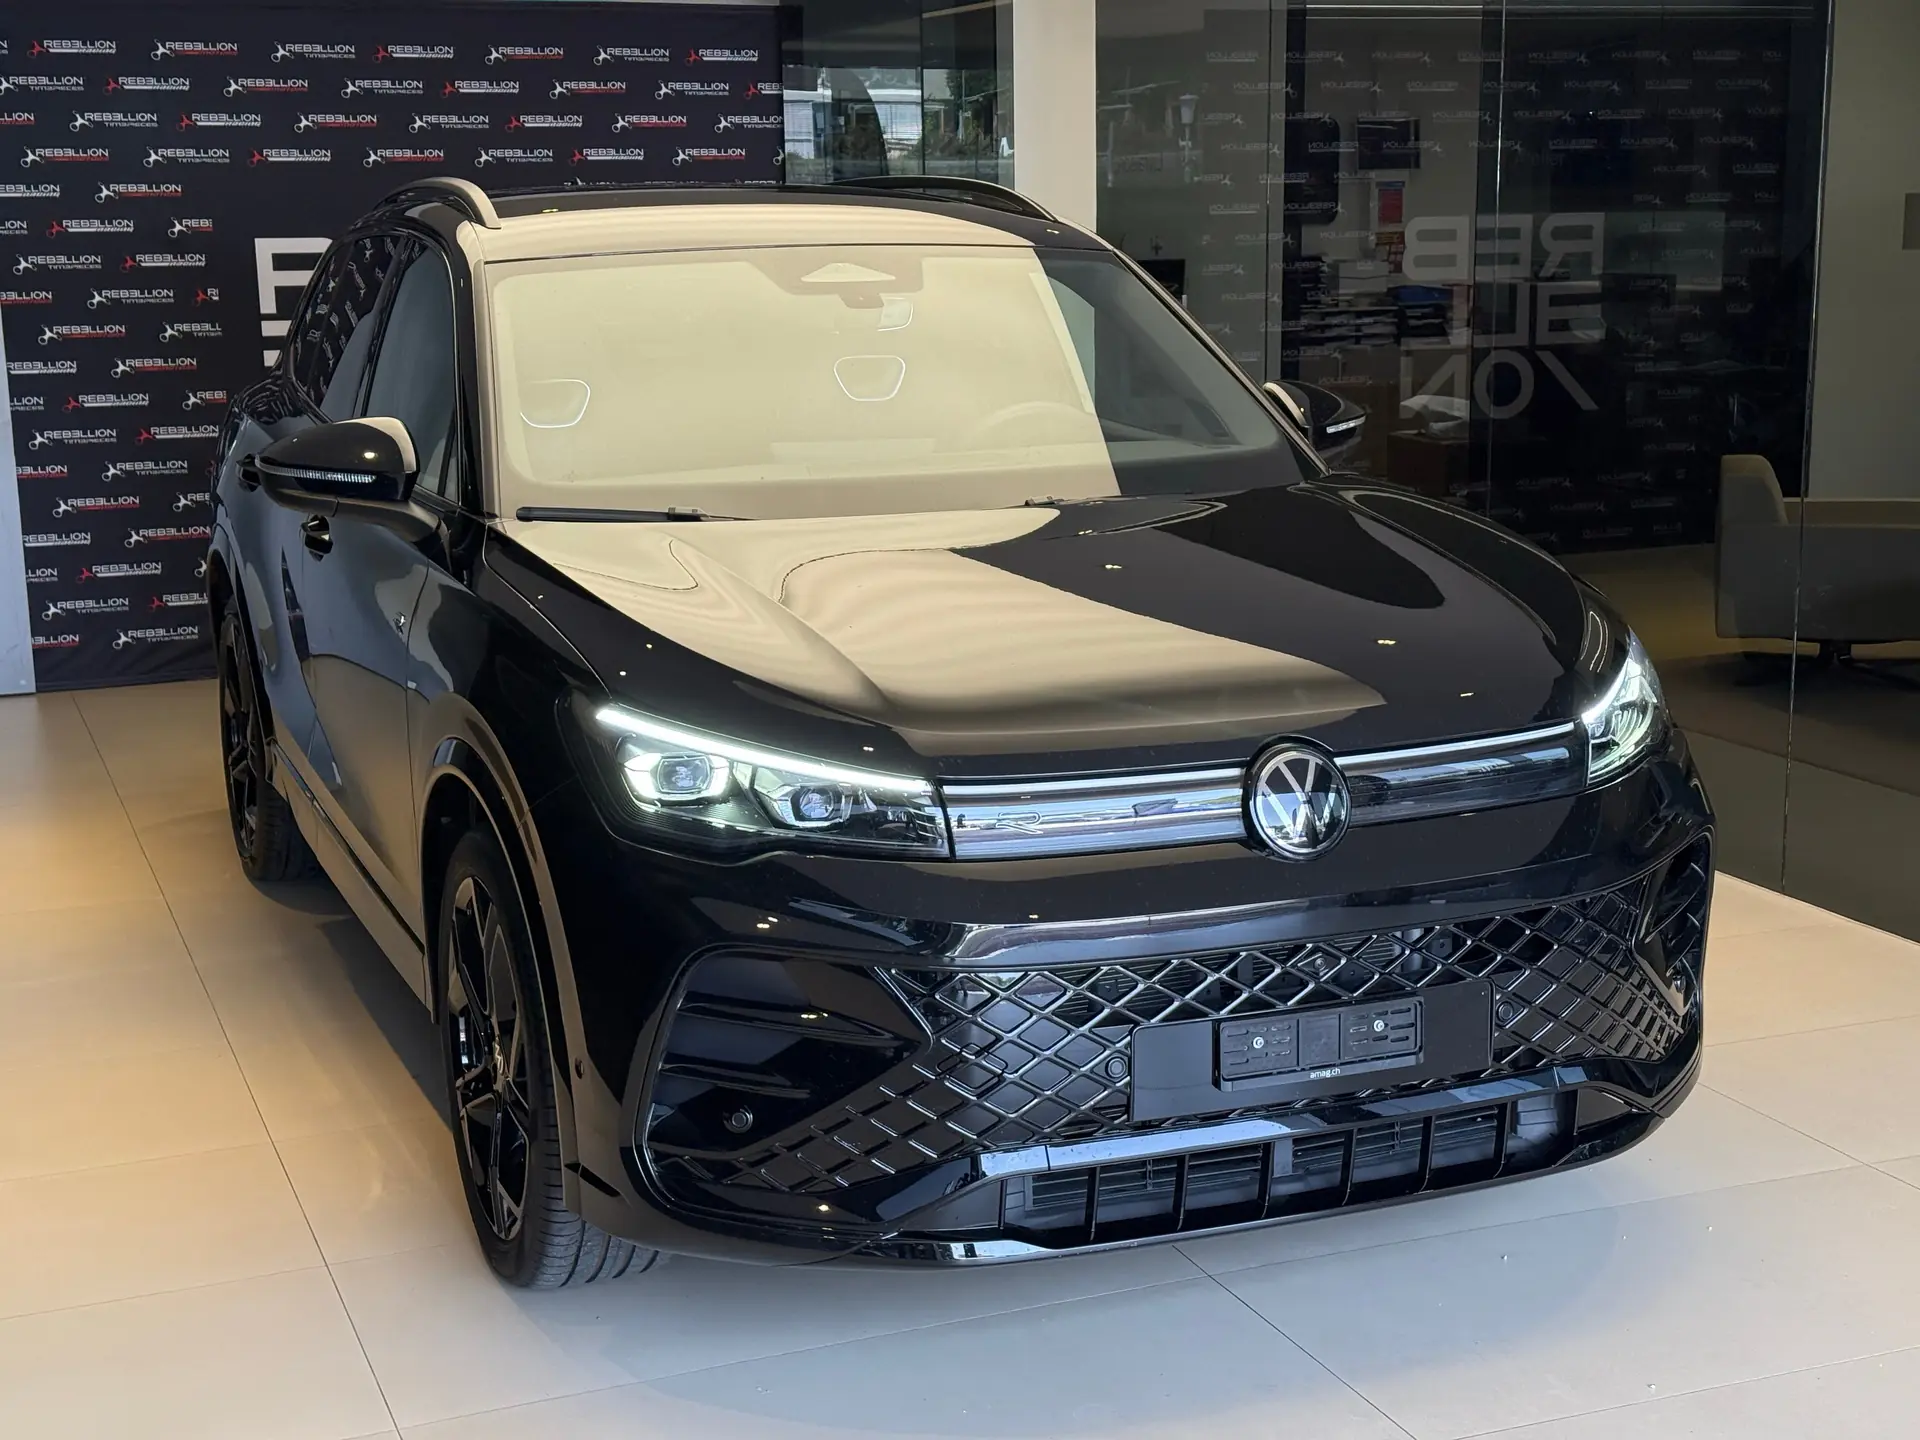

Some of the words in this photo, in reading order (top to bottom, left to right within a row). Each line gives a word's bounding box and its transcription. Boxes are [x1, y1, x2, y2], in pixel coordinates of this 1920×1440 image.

[44, 40, 116, 48] REBELLION
[166, 42, 238, 51] REBELLION
[286, 44, 355, 52] REBELLION
[607, 48, 669, 56] REBELLION
[10, 77, 83, 85] REBELLION
[119, 77, 189, 85] REBELLION
[238, 79, 308, 87] REBELLION
[355, 80, 423, 89] REBELLION
[668, 82, 729, 90] REBELLION
[84, 113, 157, 121] REBELLION
[423, 115, 488, 123] REBELLION
[520, 115, 582, 123] REBELLION
[36, 149, 108, 157] REBELLION
[158, 149, 229, 157] REBELLION
[489, 149, 552, 157] REBELLION
[110, 184, 181, 192] REBELLION
[63, 220, 133, 228] REBELLION
[28, 256, 100, 264] REBELLION
[137, 254, 205, 262] REBELLION
[102, 289, 173, 298] REBELLION
[54, 325, 125, 334] REBELLION
[126, 358, 196, 367] REBELLION
[79, 393, 148, 403] REBELLION
[44, 429, 116, 439] REBELLION
[151, 425, 218, 435] REBELLION
[117, 460, 187, 470] REBELLION
[68, 496, 139, 506] REBELLION
[140, 526, 210, 537] REBELLION
[93, 562, 161, 573] REBELLION
[58, 598, 128, 609] REBELLION
[129, 627, 198, 638] REBELLION
[31, 635, 79, 645] ELLION
[1310, 1068, 1340, 1079] amag.ch
